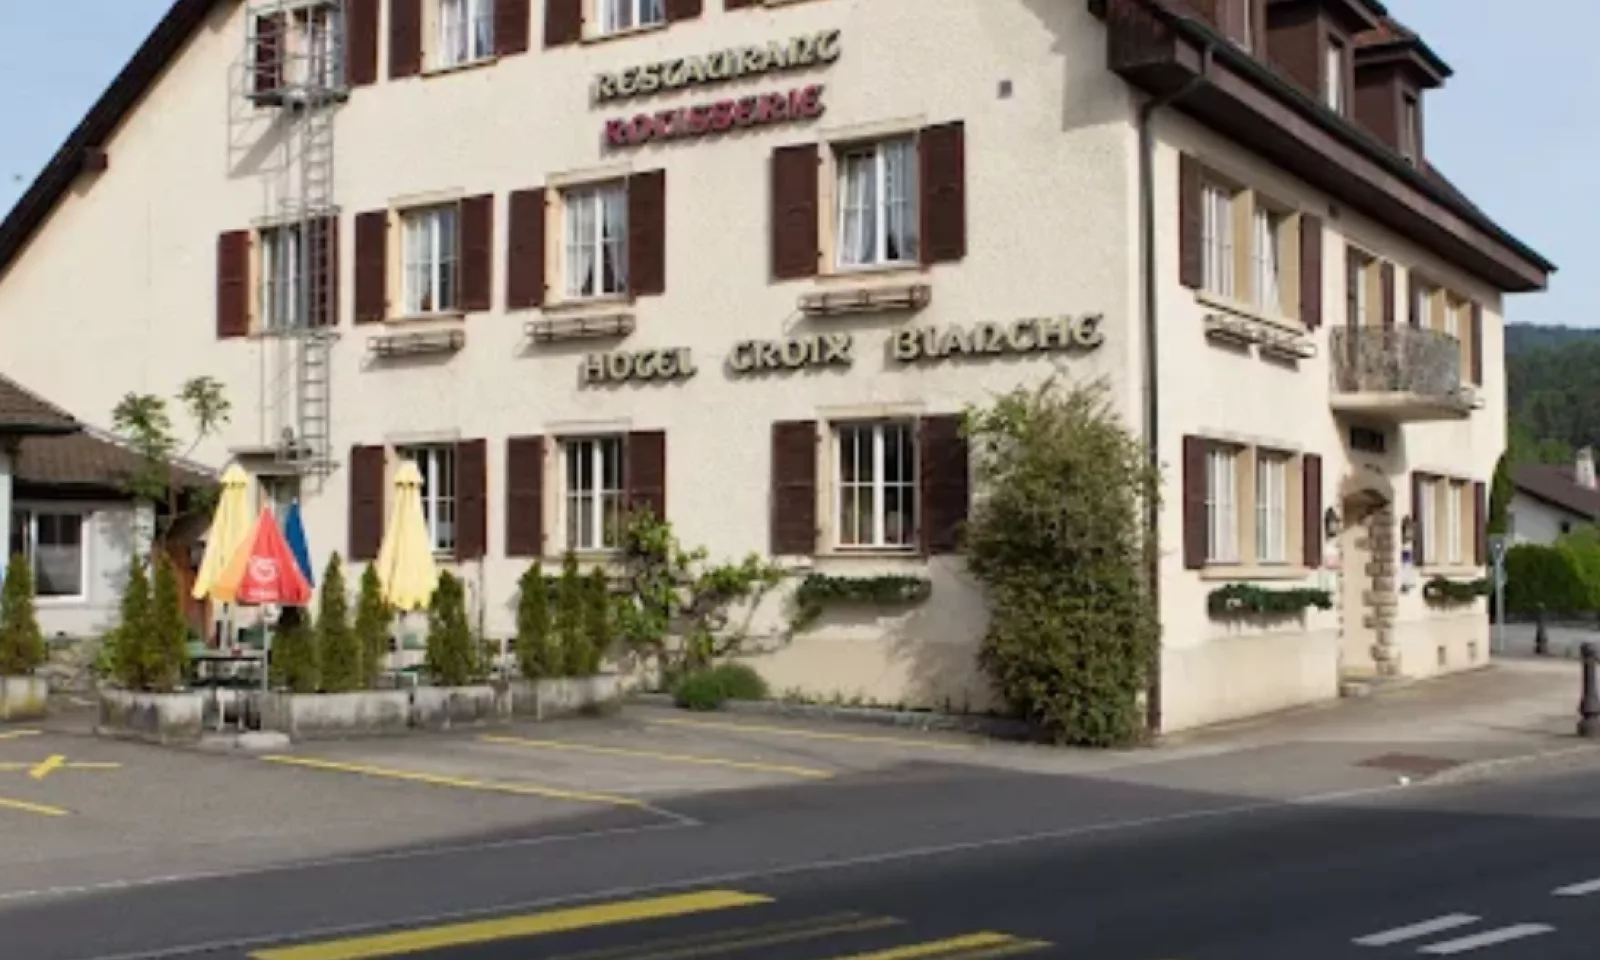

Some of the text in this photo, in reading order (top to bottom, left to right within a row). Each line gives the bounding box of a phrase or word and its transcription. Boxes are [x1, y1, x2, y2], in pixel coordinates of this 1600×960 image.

[594, 29, 841, 99] RESTAURANT
[604, 84, 825, 147] ROTISSERIE
[583, 313, 1104, 385] HOTEL CROIX BLANCHE
